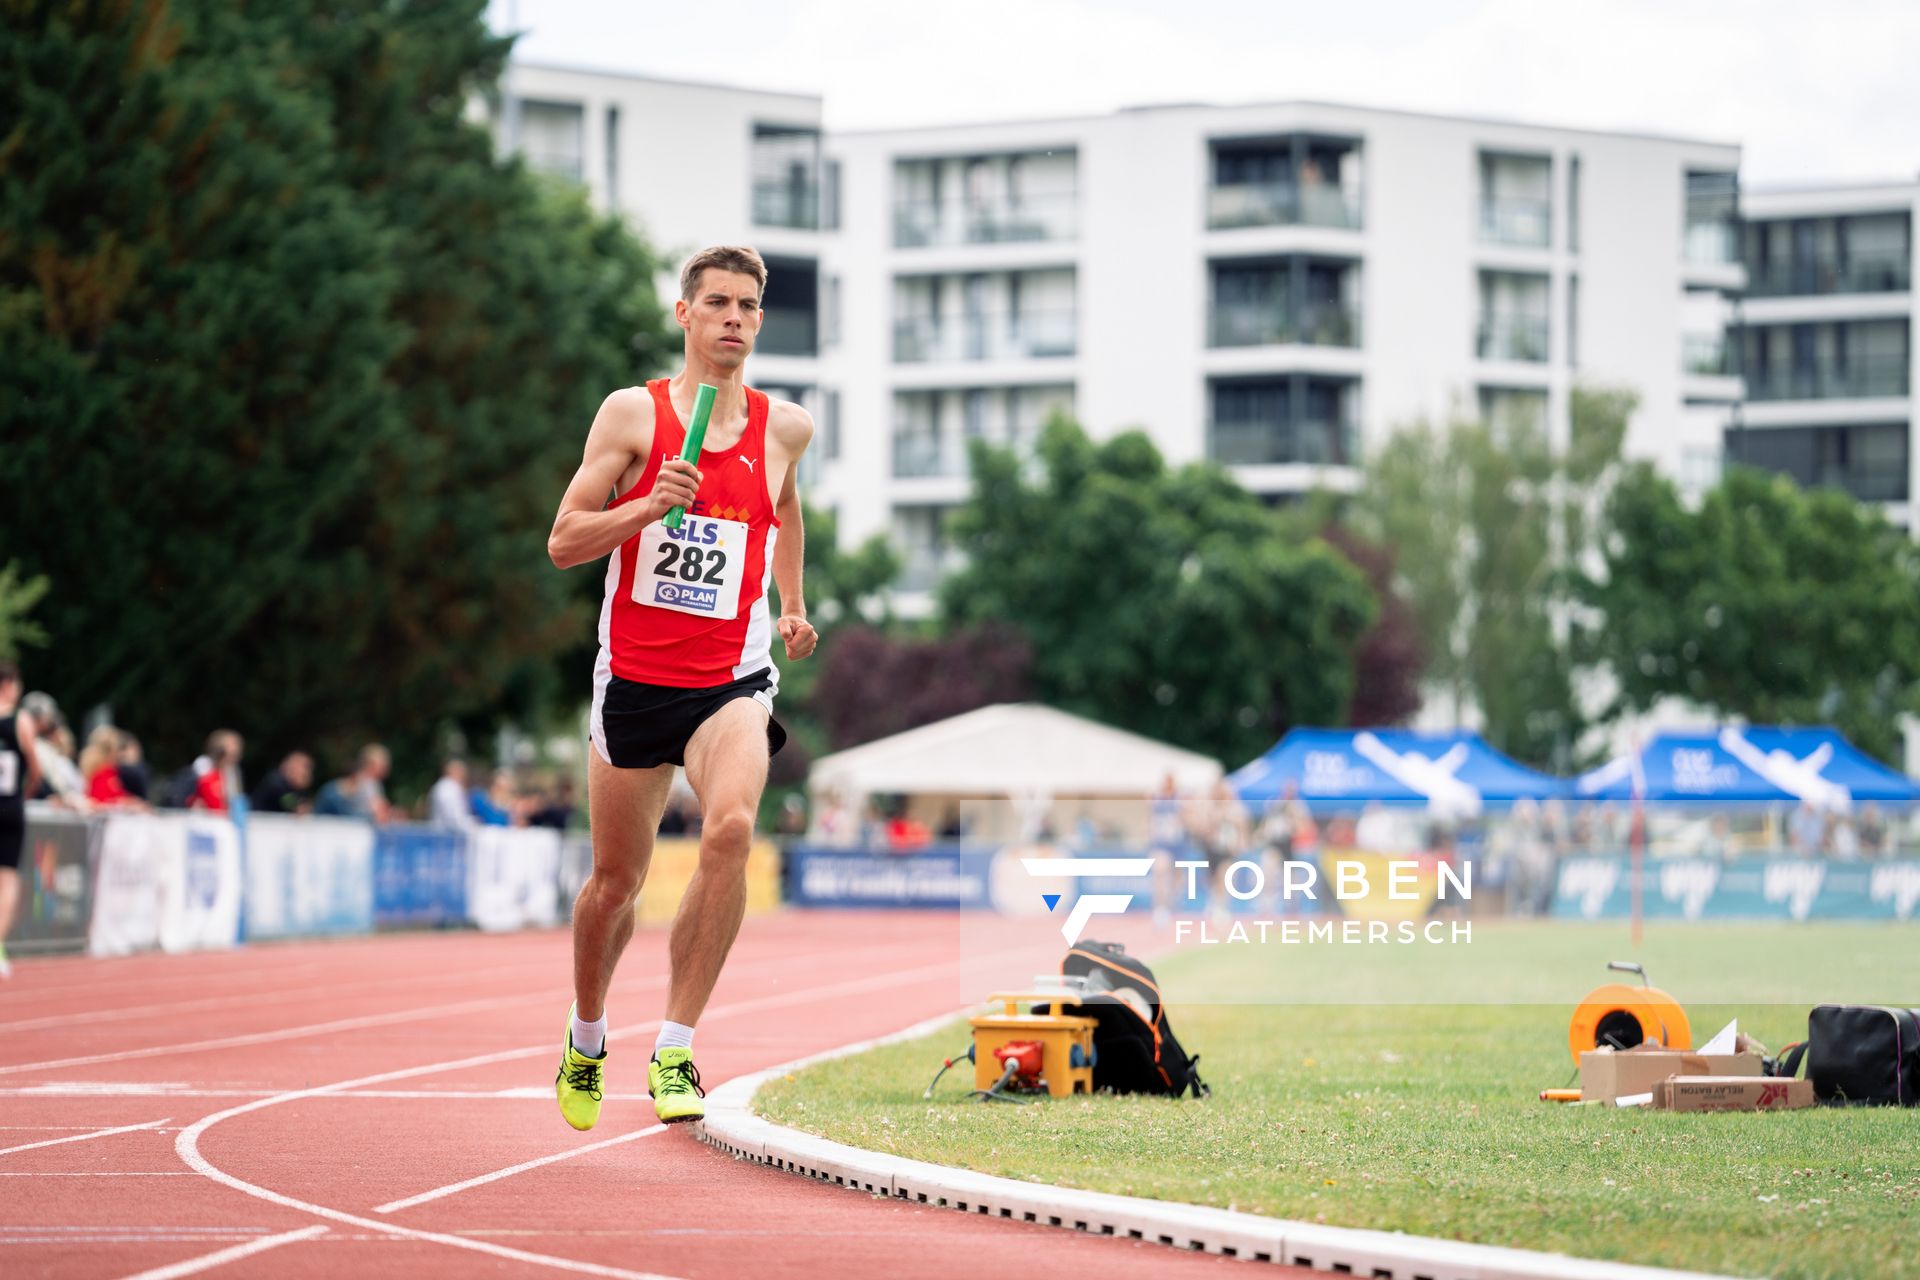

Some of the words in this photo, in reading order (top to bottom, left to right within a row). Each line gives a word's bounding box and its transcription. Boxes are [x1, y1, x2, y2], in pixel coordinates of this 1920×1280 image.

[653, 542, 726, 585] 282
[681, 589, 715, 603] PLAN
[1681, 1085, 1712, 1095] BATON
[1714, 1086, 1745, 1096] RELAY
